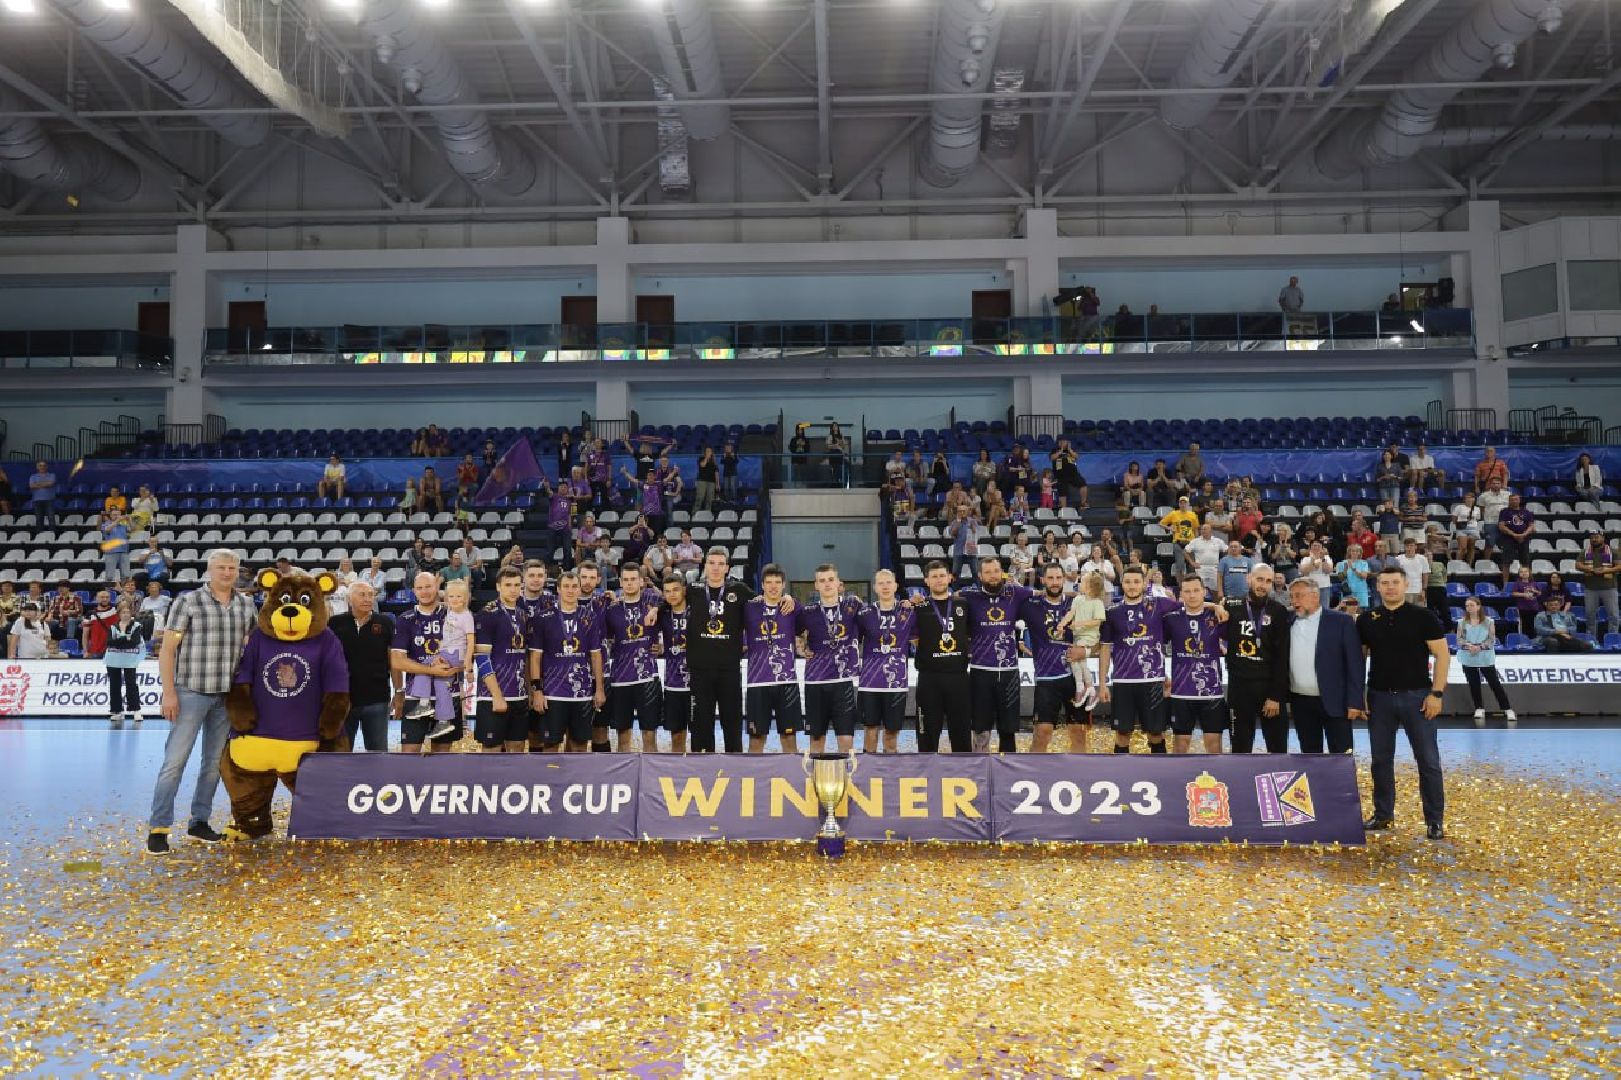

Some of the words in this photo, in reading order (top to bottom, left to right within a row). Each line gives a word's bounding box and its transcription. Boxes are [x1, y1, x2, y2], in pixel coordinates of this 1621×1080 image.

[879, 616, 896, 630] 22
[1189, 620, 1198, 633] 9
[1238, 620, 1252, 636] 12
[347, 783, 552, 815] GOVERNOR
[563, 783, 632, 815] CUP
[658, 777, 983, 818] WINNER
[1010, 780, 1162, 815] 2023
